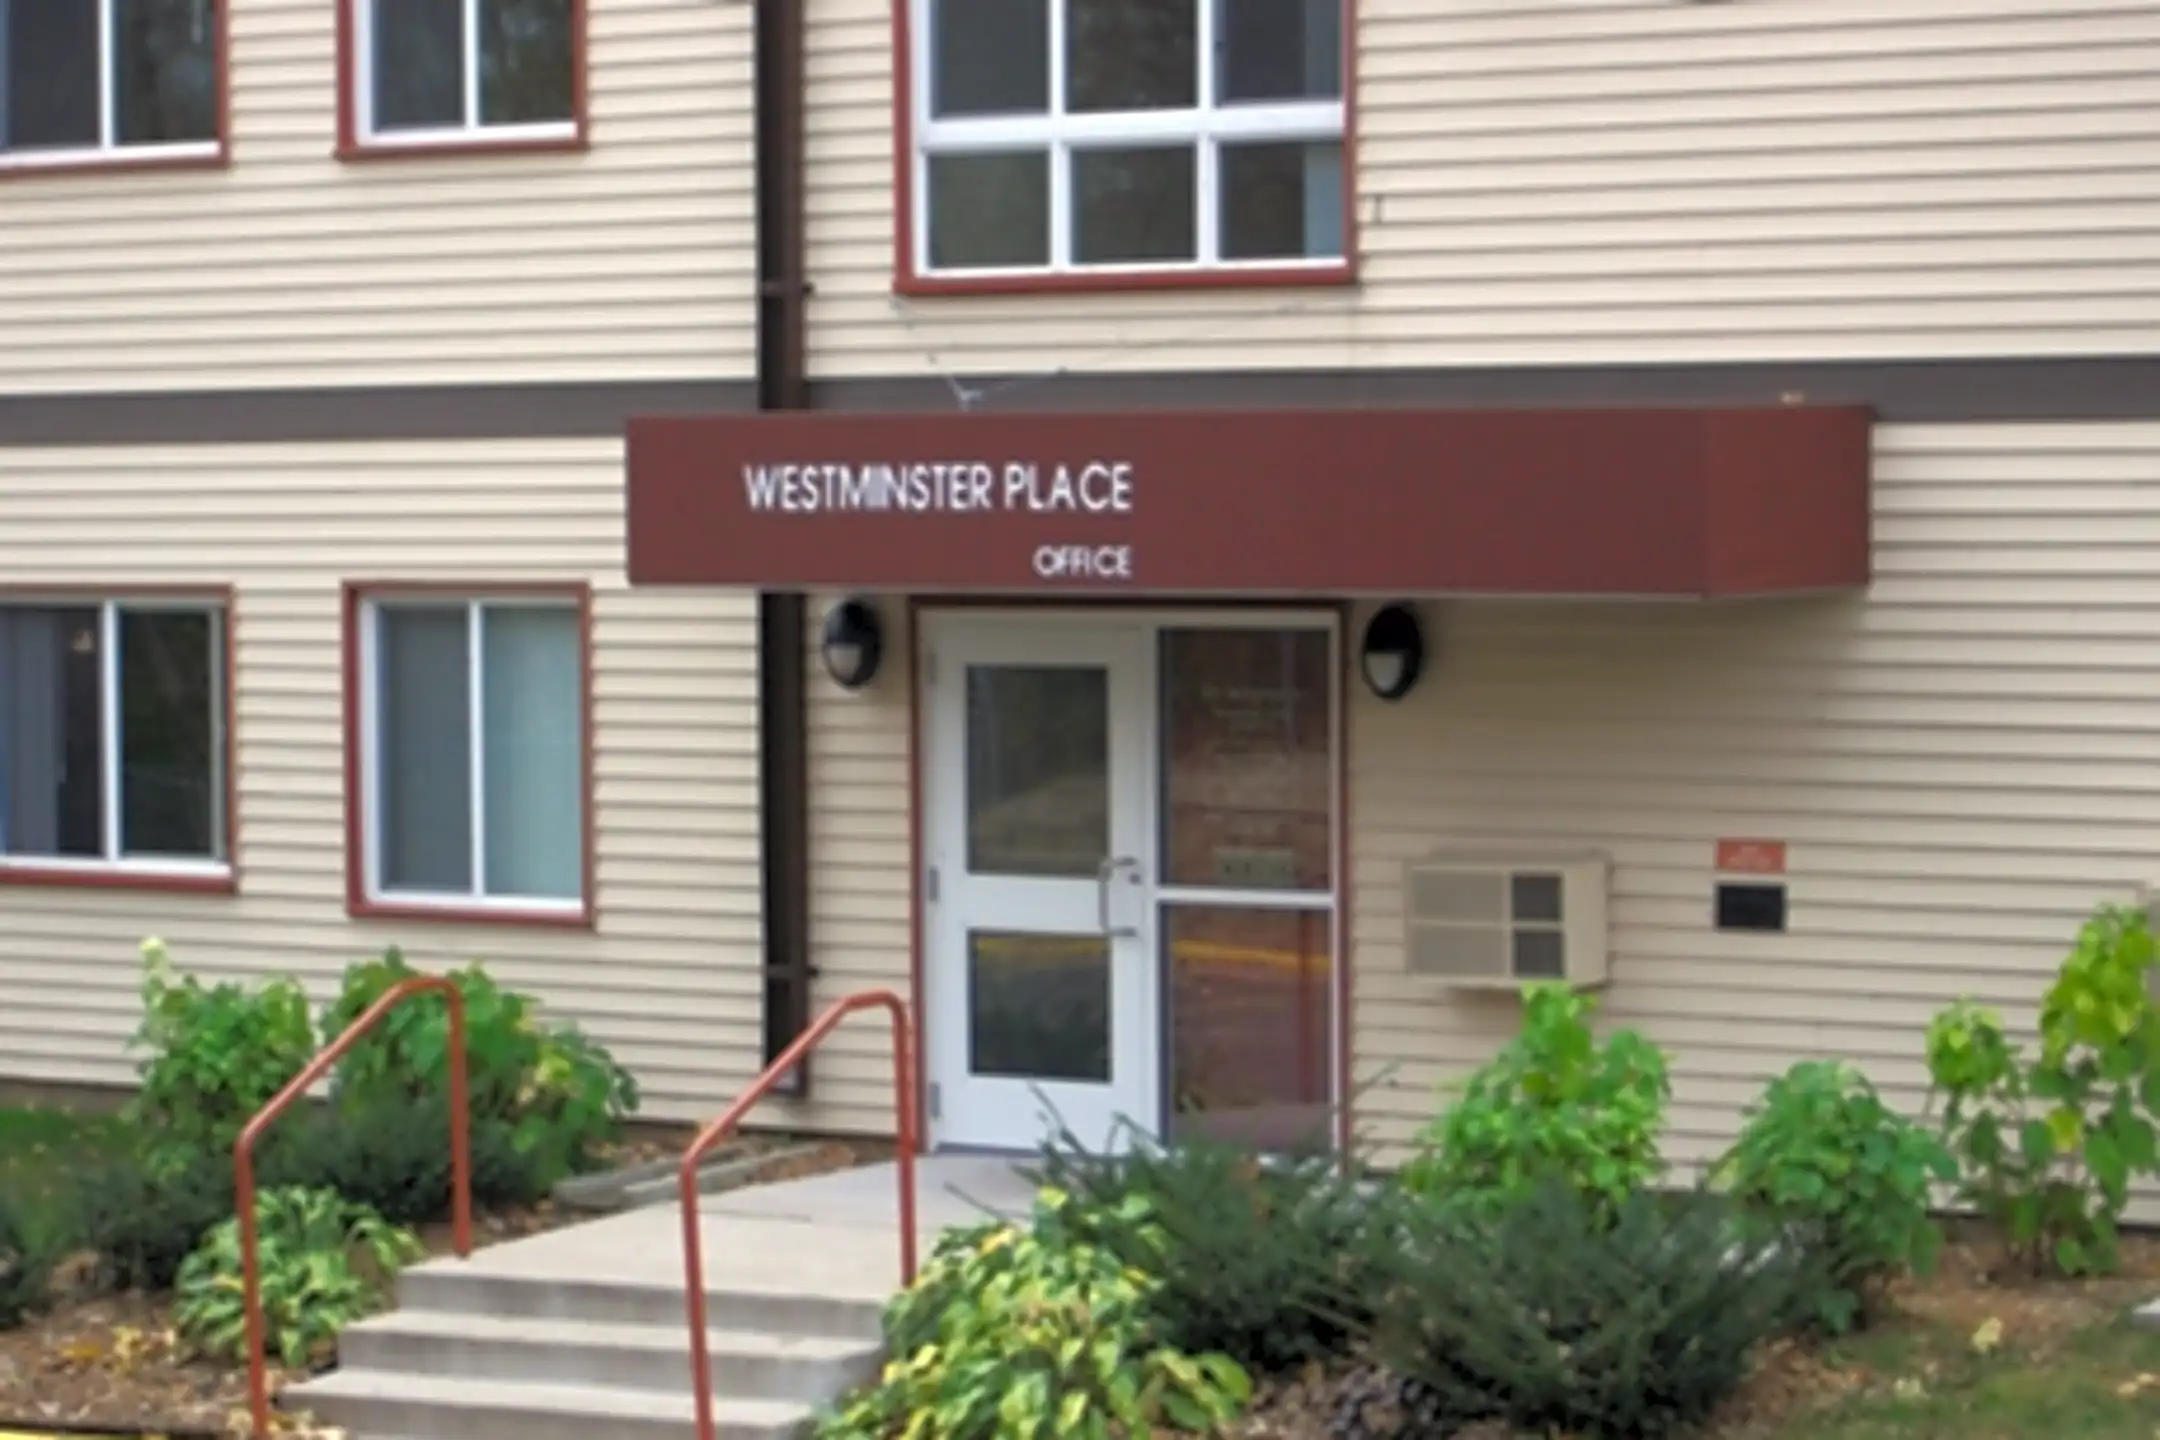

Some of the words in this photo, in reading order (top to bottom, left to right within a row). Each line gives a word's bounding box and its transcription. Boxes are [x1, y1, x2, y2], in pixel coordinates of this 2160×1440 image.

[744, 463, 993, 511] WESTMINSTER
[1003, 463, 1132, 511] PLACE
[1033, 547, 1132, 576] OFFICE
